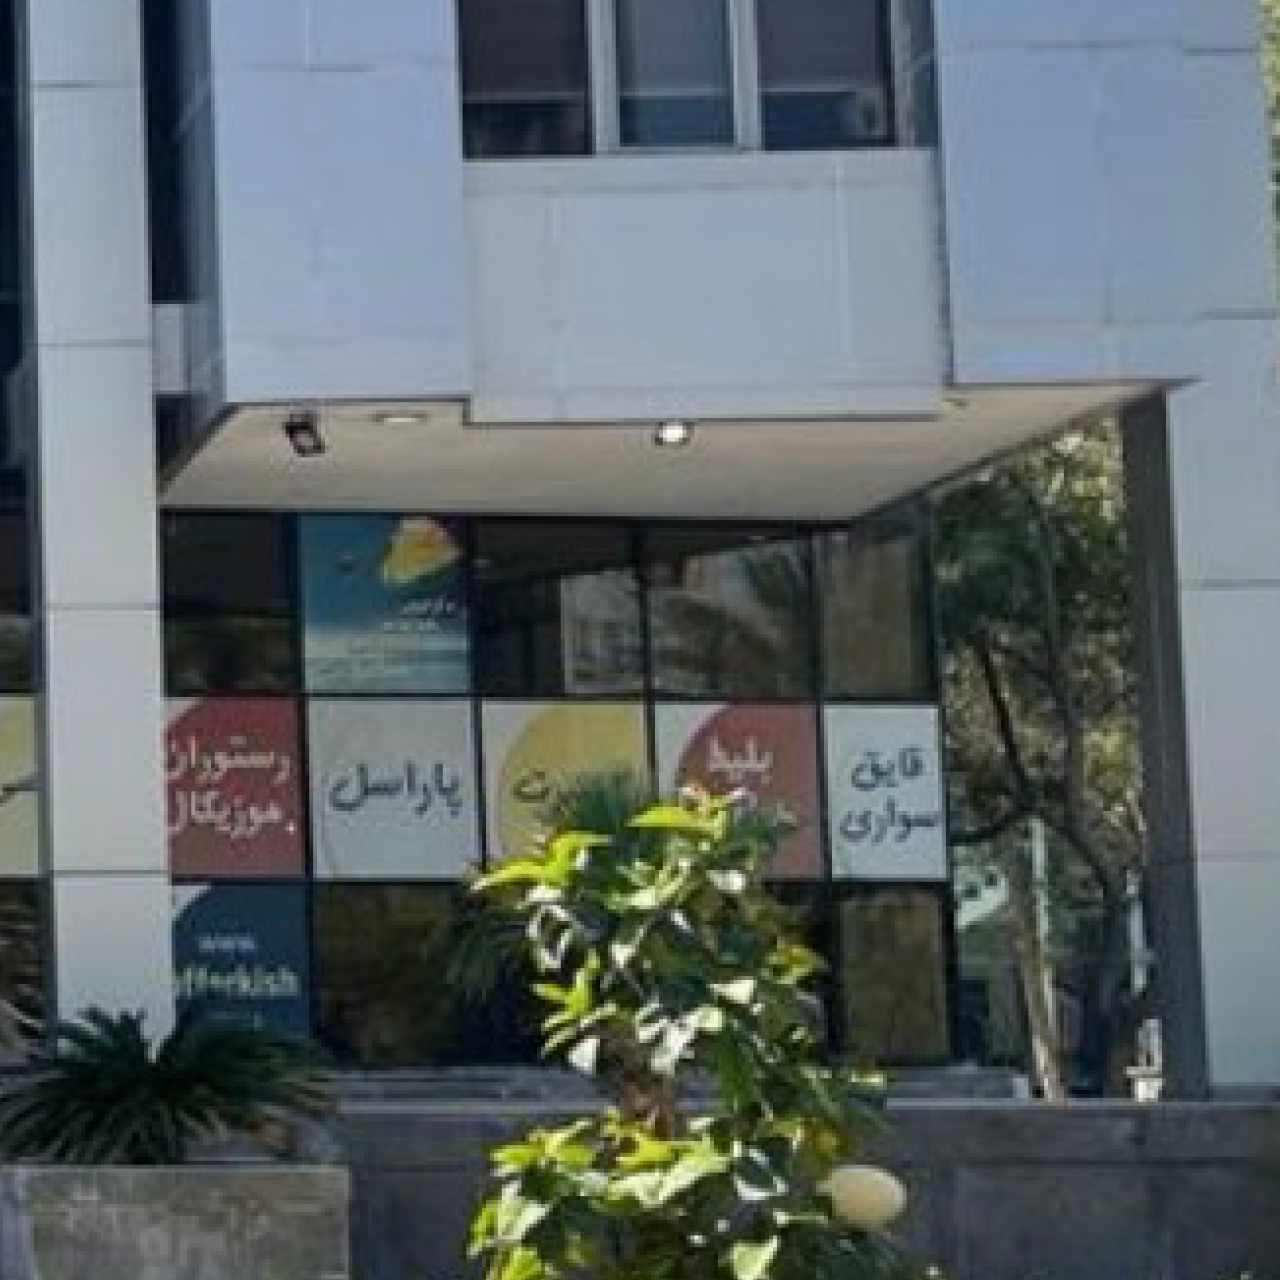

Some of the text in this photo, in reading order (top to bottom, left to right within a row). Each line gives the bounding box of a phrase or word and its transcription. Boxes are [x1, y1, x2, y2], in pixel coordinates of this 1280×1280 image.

[327, 758, 462, 818] پاراسل
[850, 746, 925, 791] قایق
[840, 801, 939, 850] سواری
